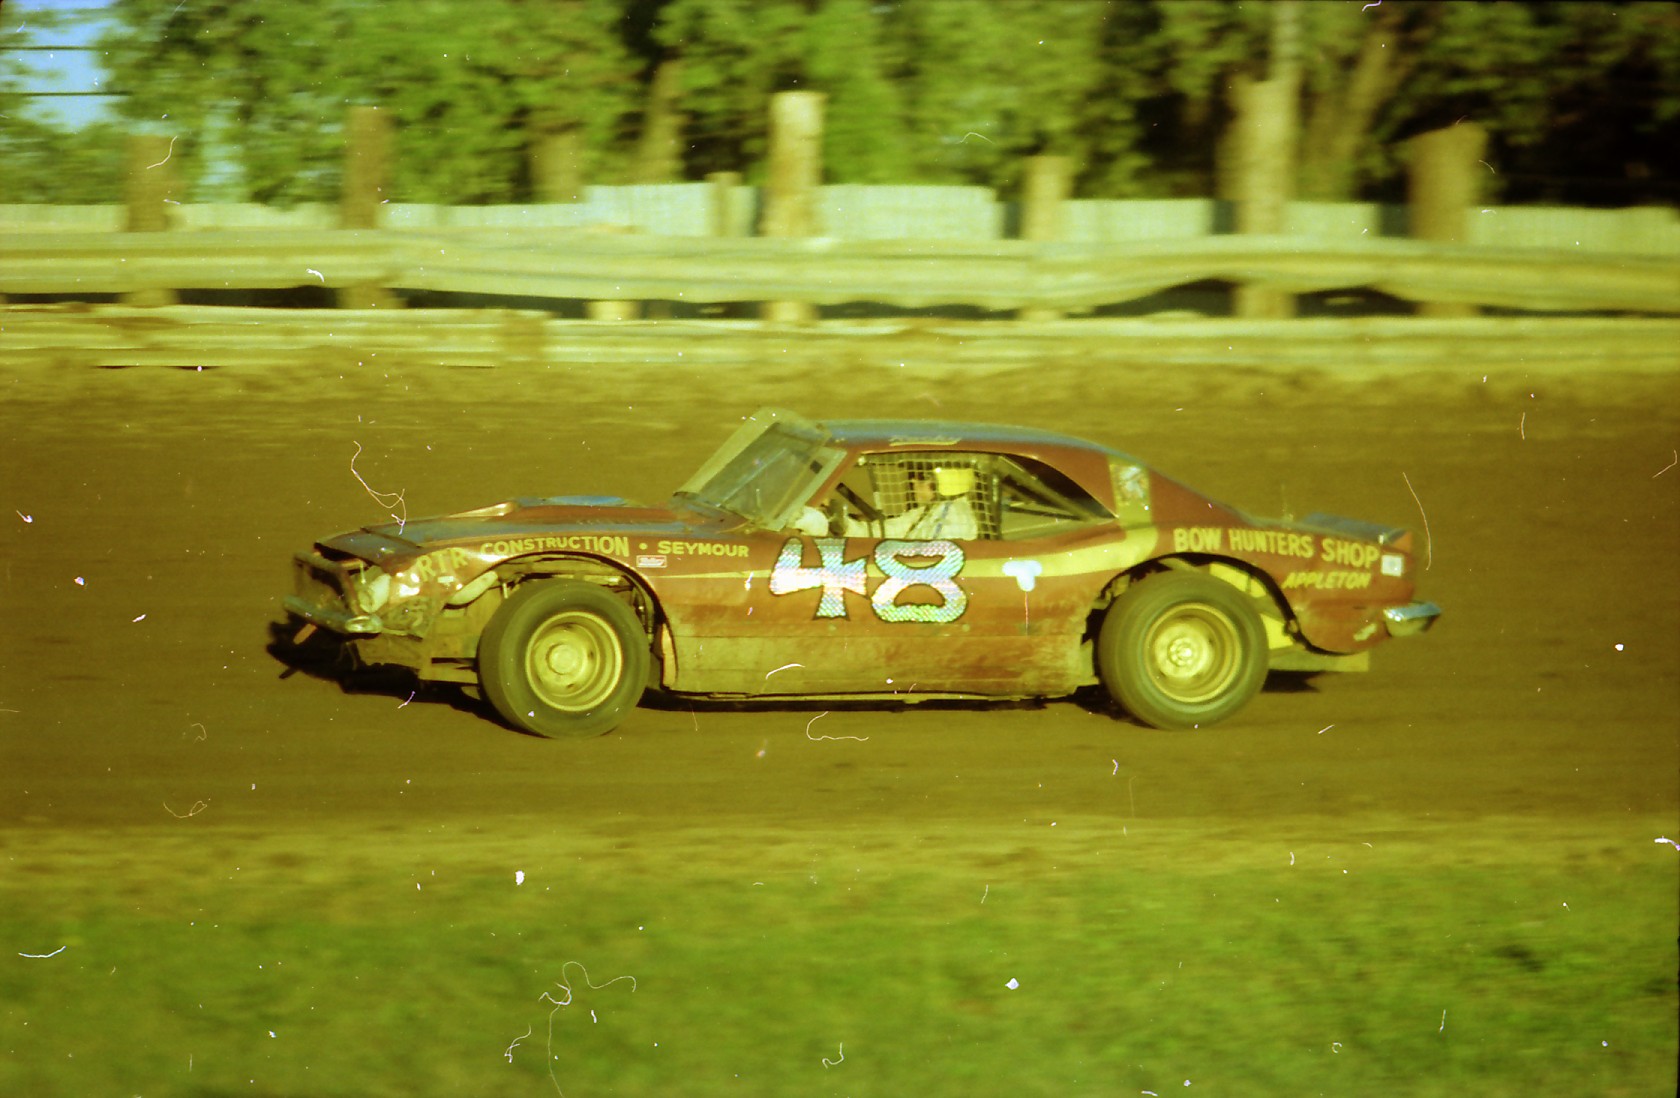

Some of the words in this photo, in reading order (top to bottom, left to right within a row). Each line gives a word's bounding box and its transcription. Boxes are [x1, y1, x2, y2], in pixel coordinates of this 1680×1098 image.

[481, 536, 629, 557] CONSTRUCTION
[657, 541, 749, 557] SEYMOUR
[1174, 528, 1222, 553] BOW
[1229, 529, 1314, 558] HUNTERS
[1321, 540, 1380, 569] SHOP
[769, 537, 967, 622] 48
[1282, 572, 1371, 589] APPLETON
